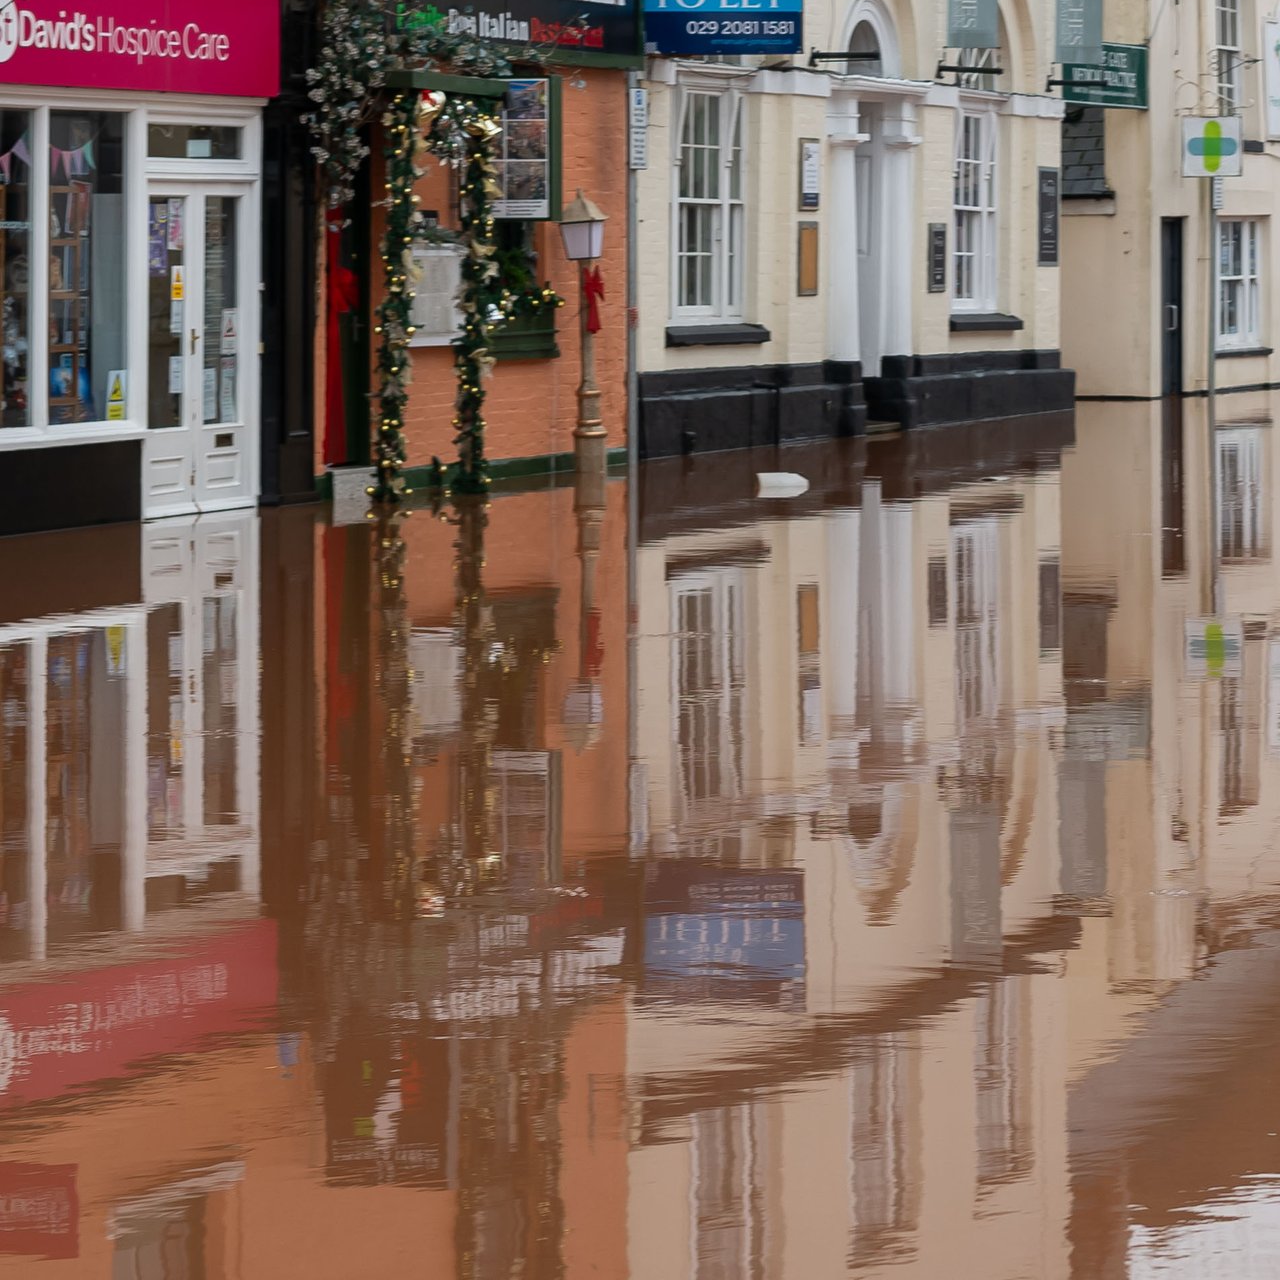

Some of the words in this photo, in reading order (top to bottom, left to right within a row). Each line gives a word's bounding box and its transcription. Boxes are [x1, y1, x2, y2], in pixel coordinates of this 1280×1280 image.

[18, 10, 96, 52] David's
[97, 16, 181, 65] Hospice
[182, 23, 230, 61] Care
[479, 12, 529, 41] Italian
[686, 21, 718, 35] 029
[721, 21, 759, 35] 2081
[762, 21, 794, 35] 1581
